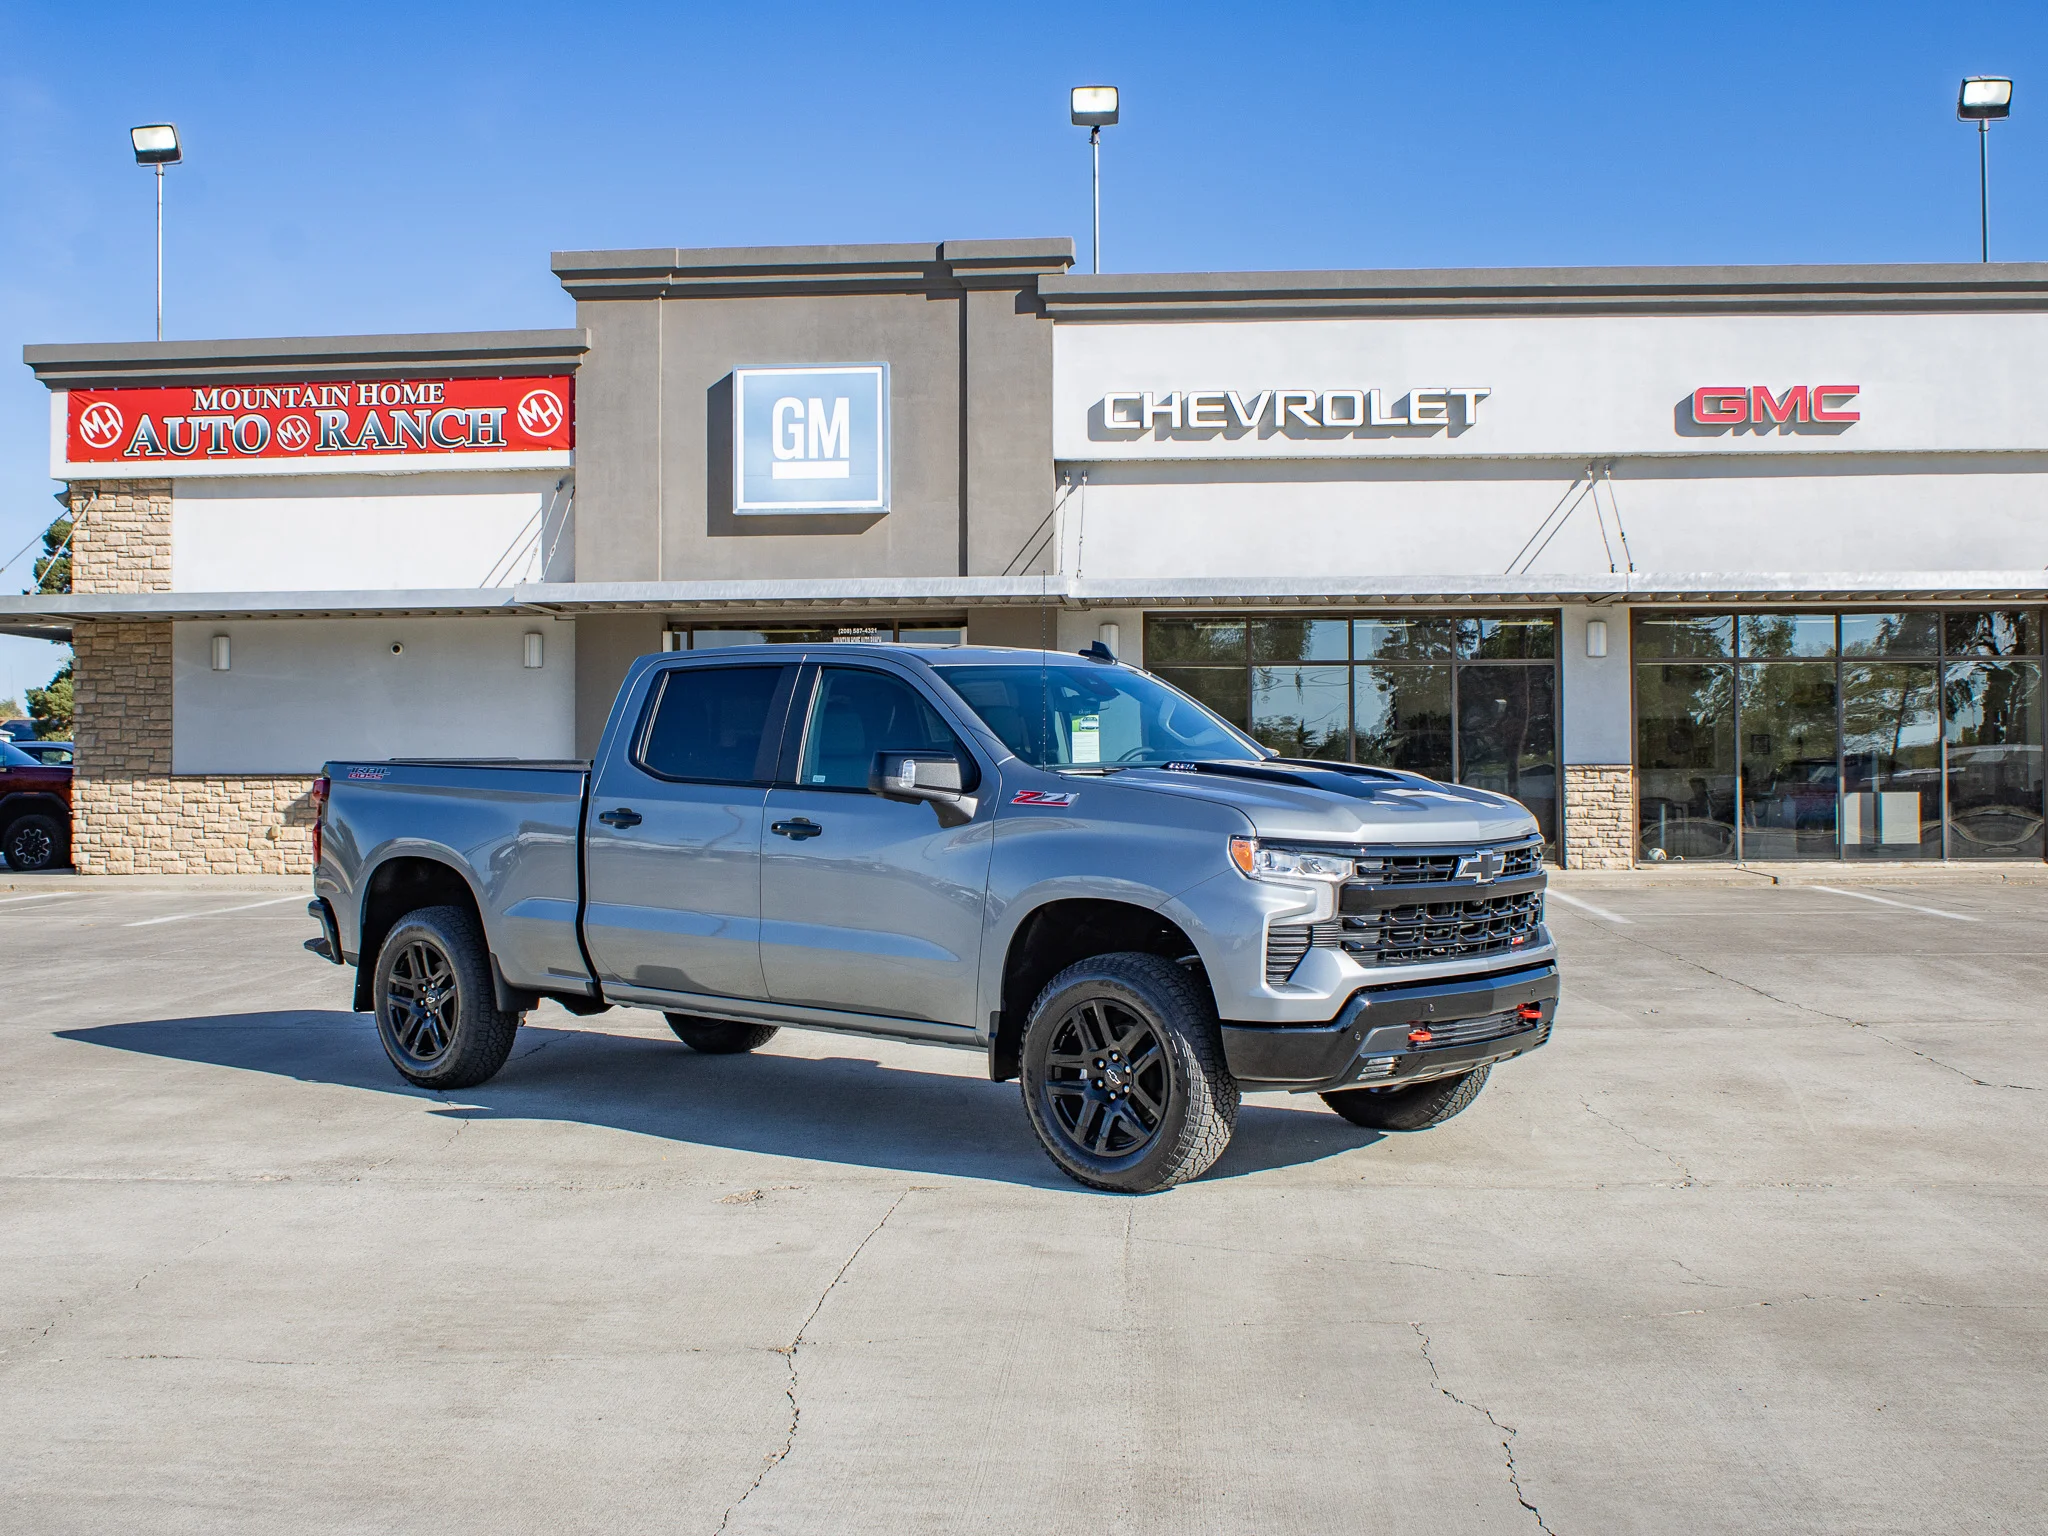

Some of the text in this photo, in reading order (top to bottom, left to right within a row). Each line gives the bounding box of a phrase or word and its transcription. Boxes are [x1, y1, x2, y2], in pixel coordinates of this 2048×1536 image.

[192, 383, 445, 411] MOUNTAIN HOME
[1104, 388, 1492, 429] CHEVROLET
[1693, 385, 1860, 424] GMC
[124, 414, 271, 457] AUTO
[314, 407, 507, 451] RANCH
[772, 396, 850, 460] GM
[1010, 790, 1080, 807] Z71
